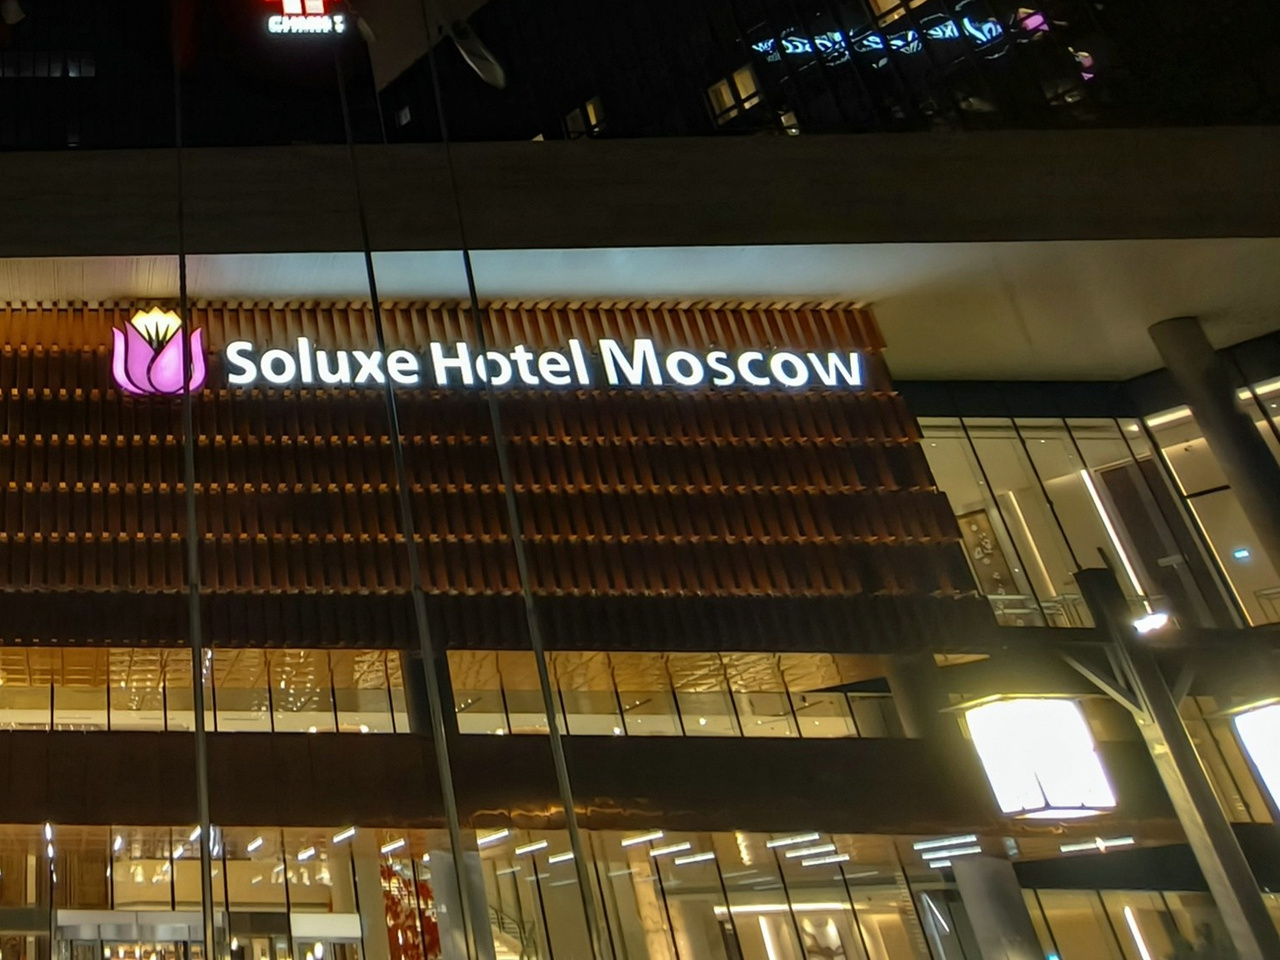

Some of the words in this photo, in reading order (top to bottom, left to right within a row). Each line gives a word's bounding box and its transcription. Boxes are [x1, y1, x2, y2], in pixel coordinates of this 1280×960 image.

[226, 336, 419, 386] Soluxe
[430, 338, 590, 386] Hotel
[600, 338, 862, 388] Moscow
